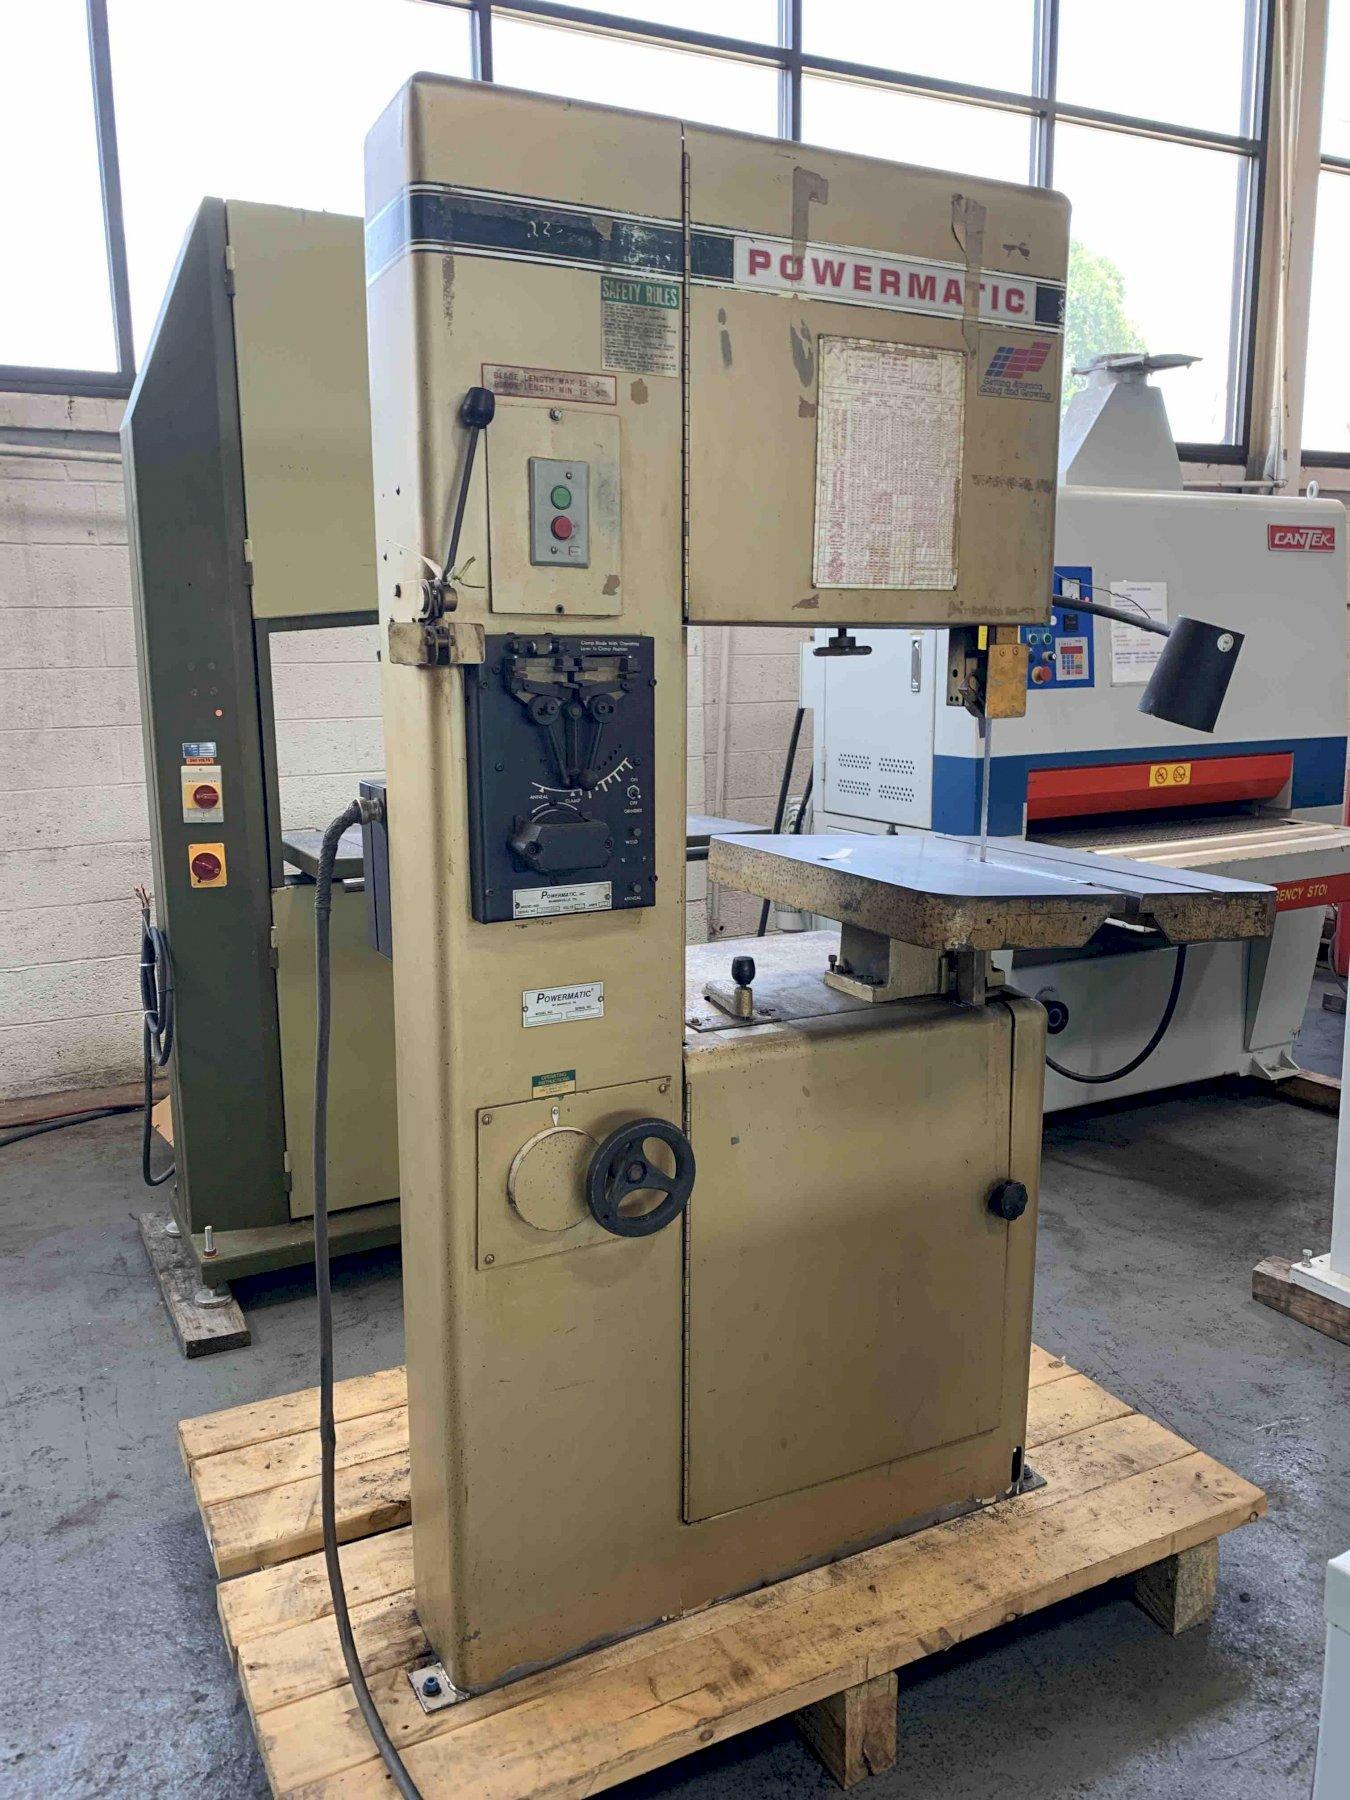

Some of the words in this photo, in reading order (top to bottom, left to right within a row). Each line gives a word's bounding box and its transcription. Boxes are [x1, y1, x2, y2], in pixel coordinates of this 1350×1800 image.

[748, 248, 1026, 314] POWERMAIC
[602, 279, 640, 302] SAFETY
[646, 285, 678, 307] RULES
[523, 382, 554, 393] LENGTH
[524, 373, 555, 384] LENGTH
[1274, 529, 1335, 551] CANTEK
[1307, 884, 1328, 898] STO
